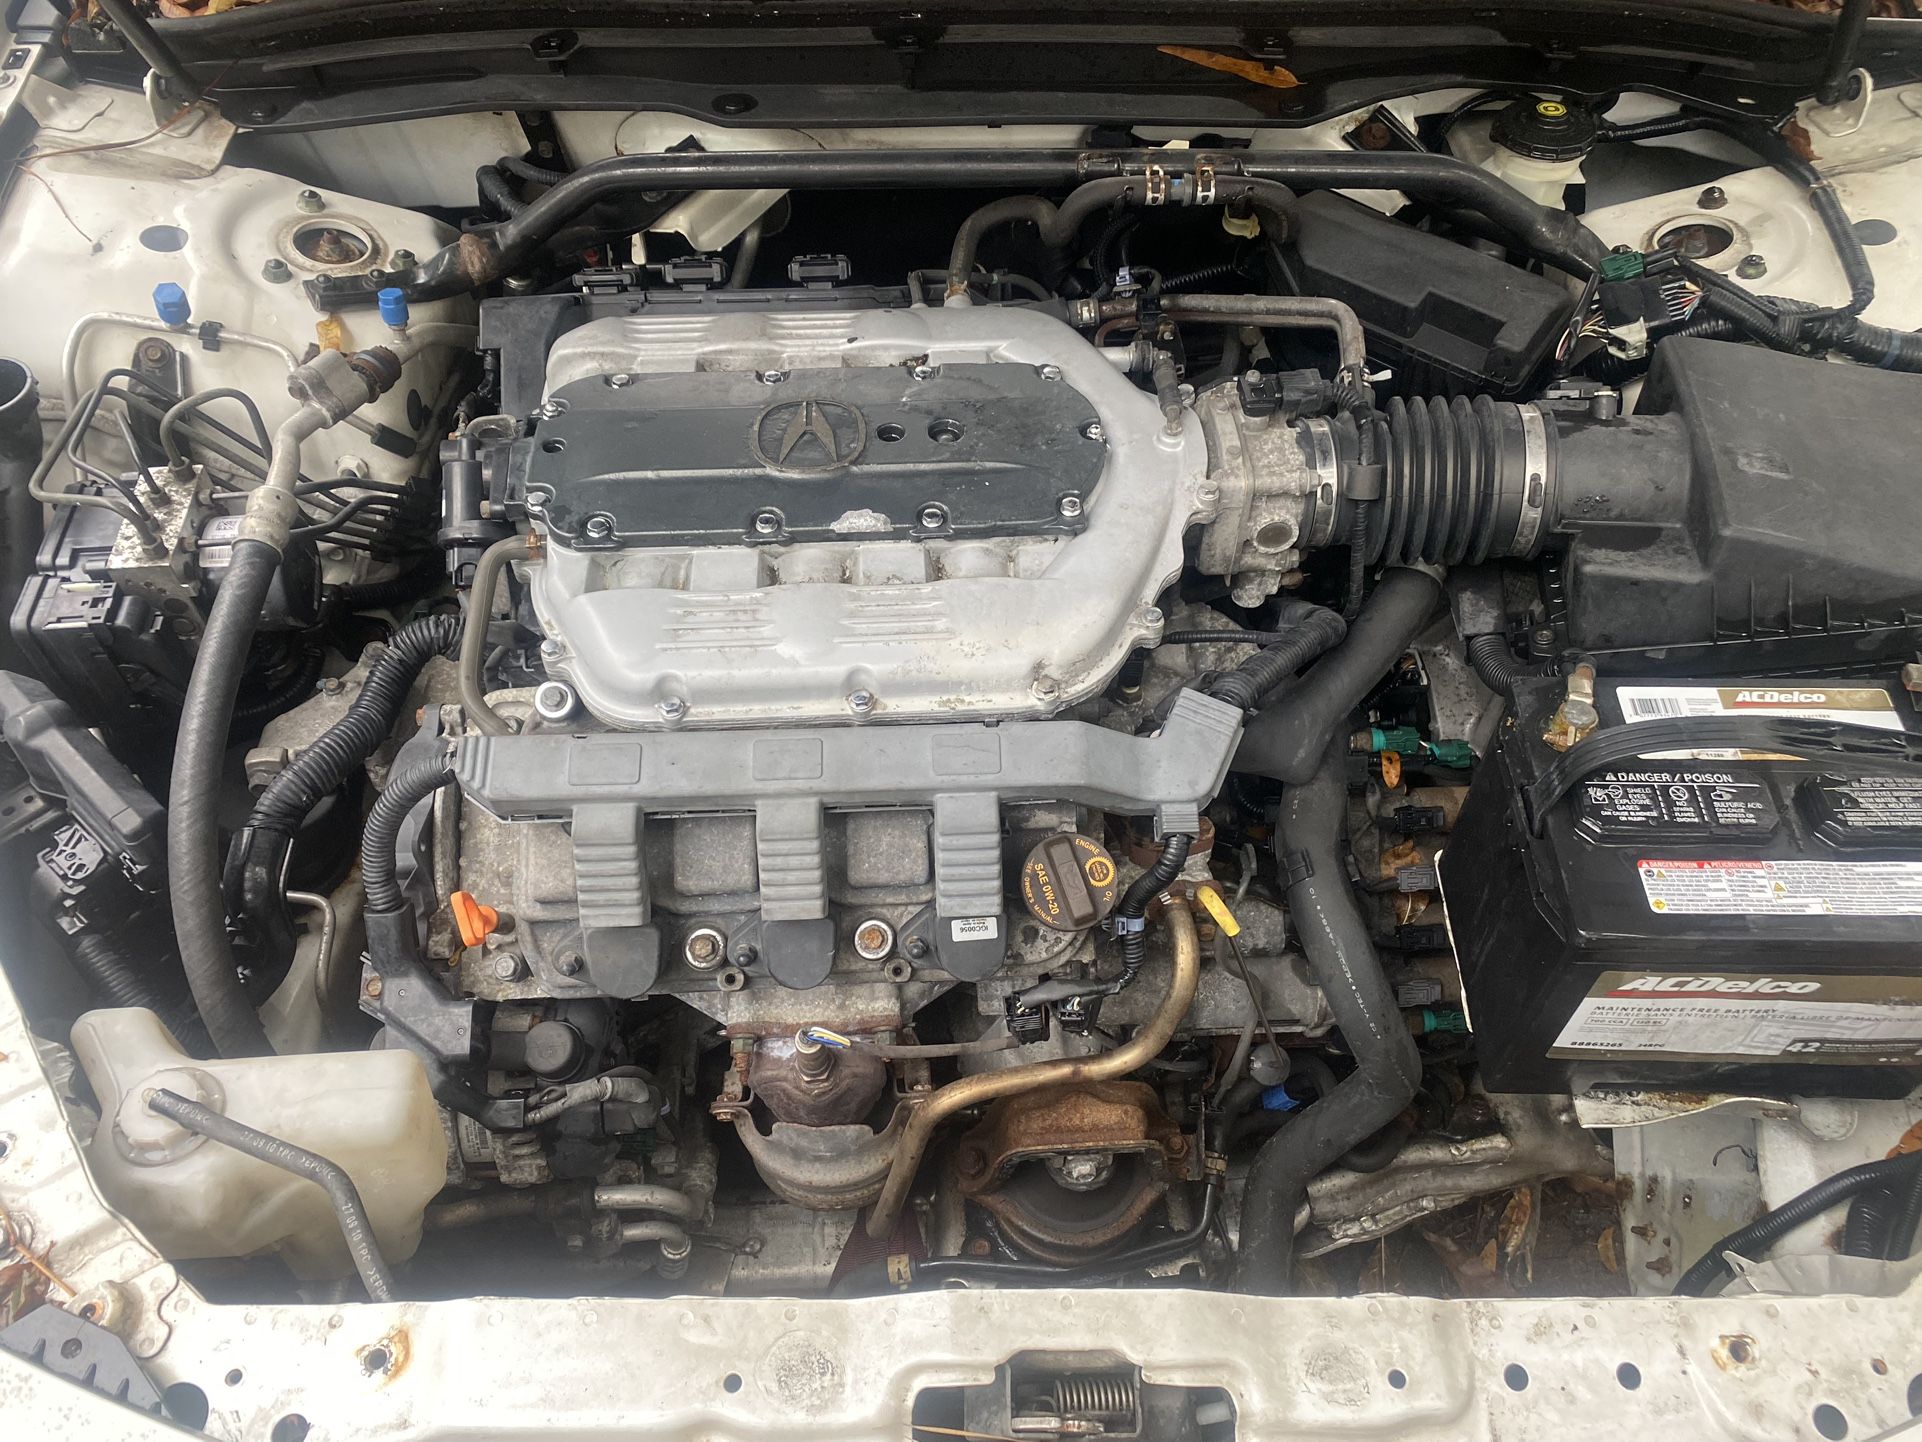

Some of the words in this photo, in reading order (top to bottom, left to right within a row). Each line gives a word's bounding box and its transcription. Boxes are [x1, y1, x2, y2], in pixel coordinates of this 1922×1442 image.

[1735, 690, 1826, 703] ACDelco
[1618, 773, 1671, 783] DANGER
[1674, 774, 1681, 783] /
[1684, 774, 1733, 783] POISON
[1075, 838, 1101, 856] ENGINE
[1034, 863, 1049, 885] SAE
[1042, 884, 1060, 915] 0W-20
[1102, 890, 1113, 903] OIL
[1617, 976, 1822, 994] ACDelco
[1593, 1005, 1686, 1013] MAINTENANCE
[1785, 1042, 1821, 1053] 42
